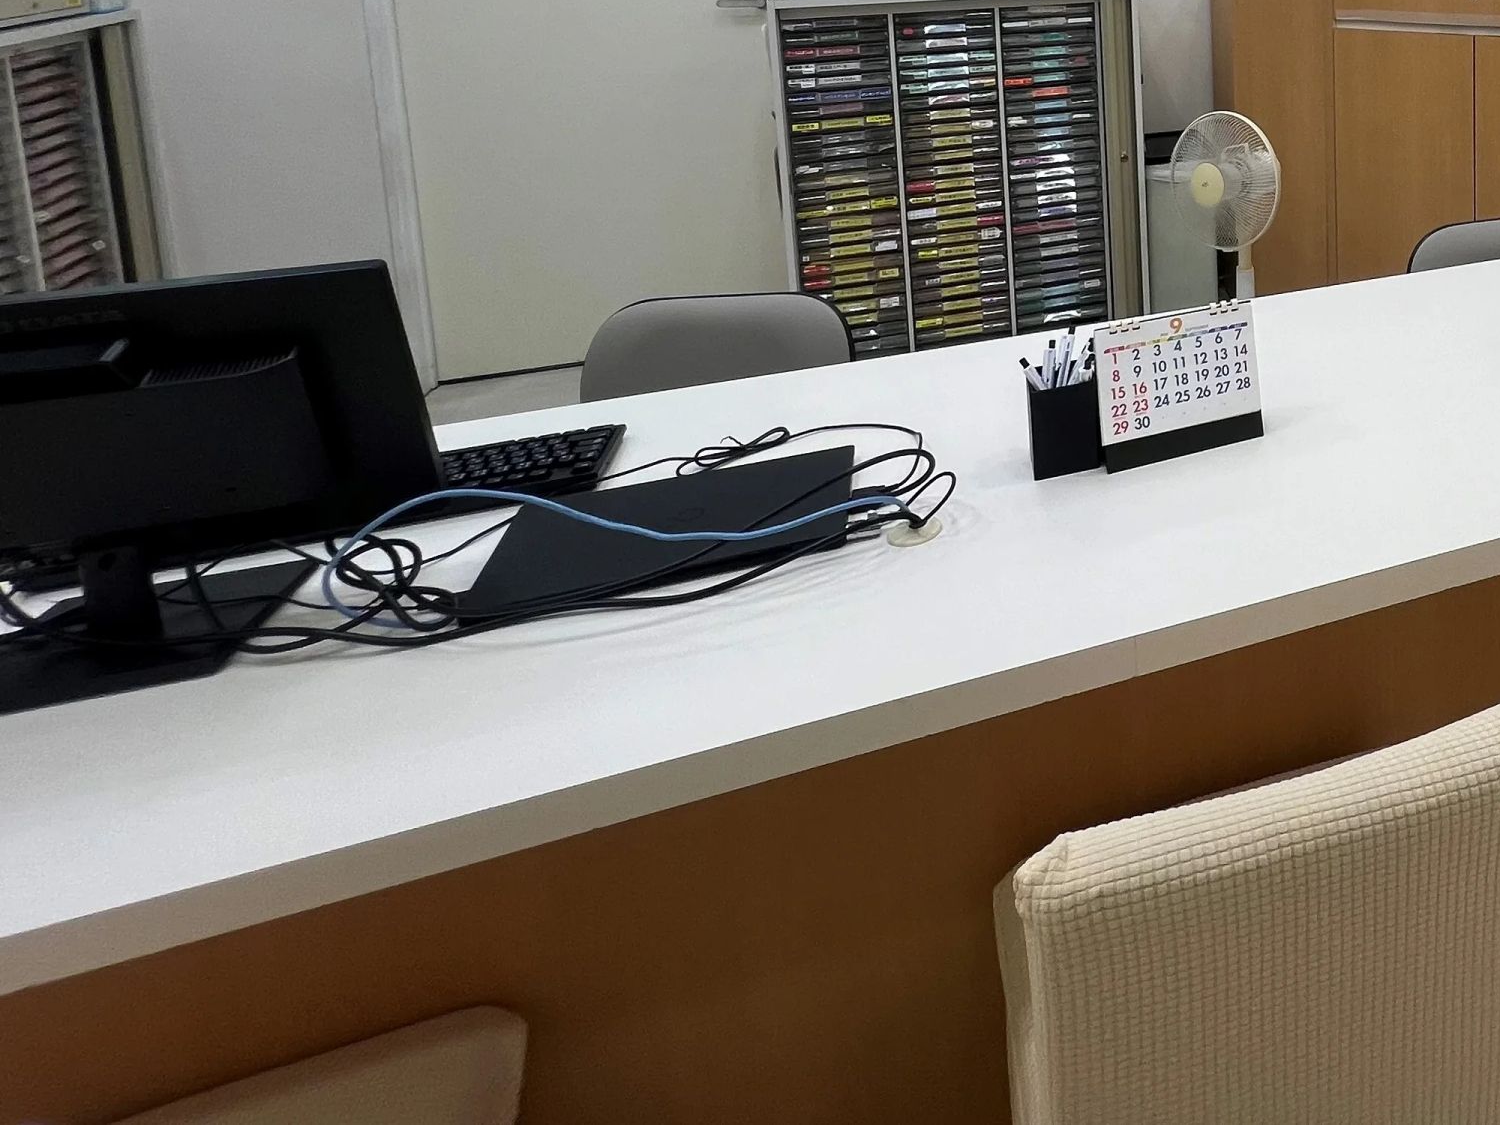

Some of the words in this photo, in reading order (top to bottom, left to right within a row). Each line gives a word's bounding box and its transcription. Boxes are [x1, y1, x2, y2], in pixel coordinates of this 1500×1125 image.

[1170, 318, 1183, 334] 9
[1112, 353, 1117, 365] 1
[1132, 348, 1141, 361] 2
[1153, 344, 1161, 356] 3
[1174, 340, 1182, 351] 4
[1195, 336, 1202, 348] 5
[1215, 332, 1223, 344] 6
[1234, 328, 1242, 340] 7
[1112, 370, 1120, 382] 8
[1133, 365, 1142, 378] 9
[1152, 360, 1167, 373] 10
[1173, 356, 1186, 369] 11
[1194, 352, 1208, 365] 12
[1214, 348, 1228, 361] 13
[1234, 343, 1248, 357] 14
[1111, 386, 1126, 400] 15
[1132, 381, 1147, 395] 16
[1153, 376, 1168, 391] 17
[1174, 373, 1189, 386] 18
[1195, 368, 1209, 382] 19
[1214, 364, 1229, 378] 20
[1234, 360, 1247, 374] 21
[1111, 403, 1128, 418] 22
[1132, 398, 1149, 413] 23
[1154, 393, 1170, 408] 24
[1175, 389, 1190, 403] 25
[1195, 385, 1211, 399] 26
[1216, 380, 1230, 395] 27
[1235, 376, 1251, 390] 28
[1112, 420, 1129, 435] 29
[1134, 416, 1150, 430] 30
